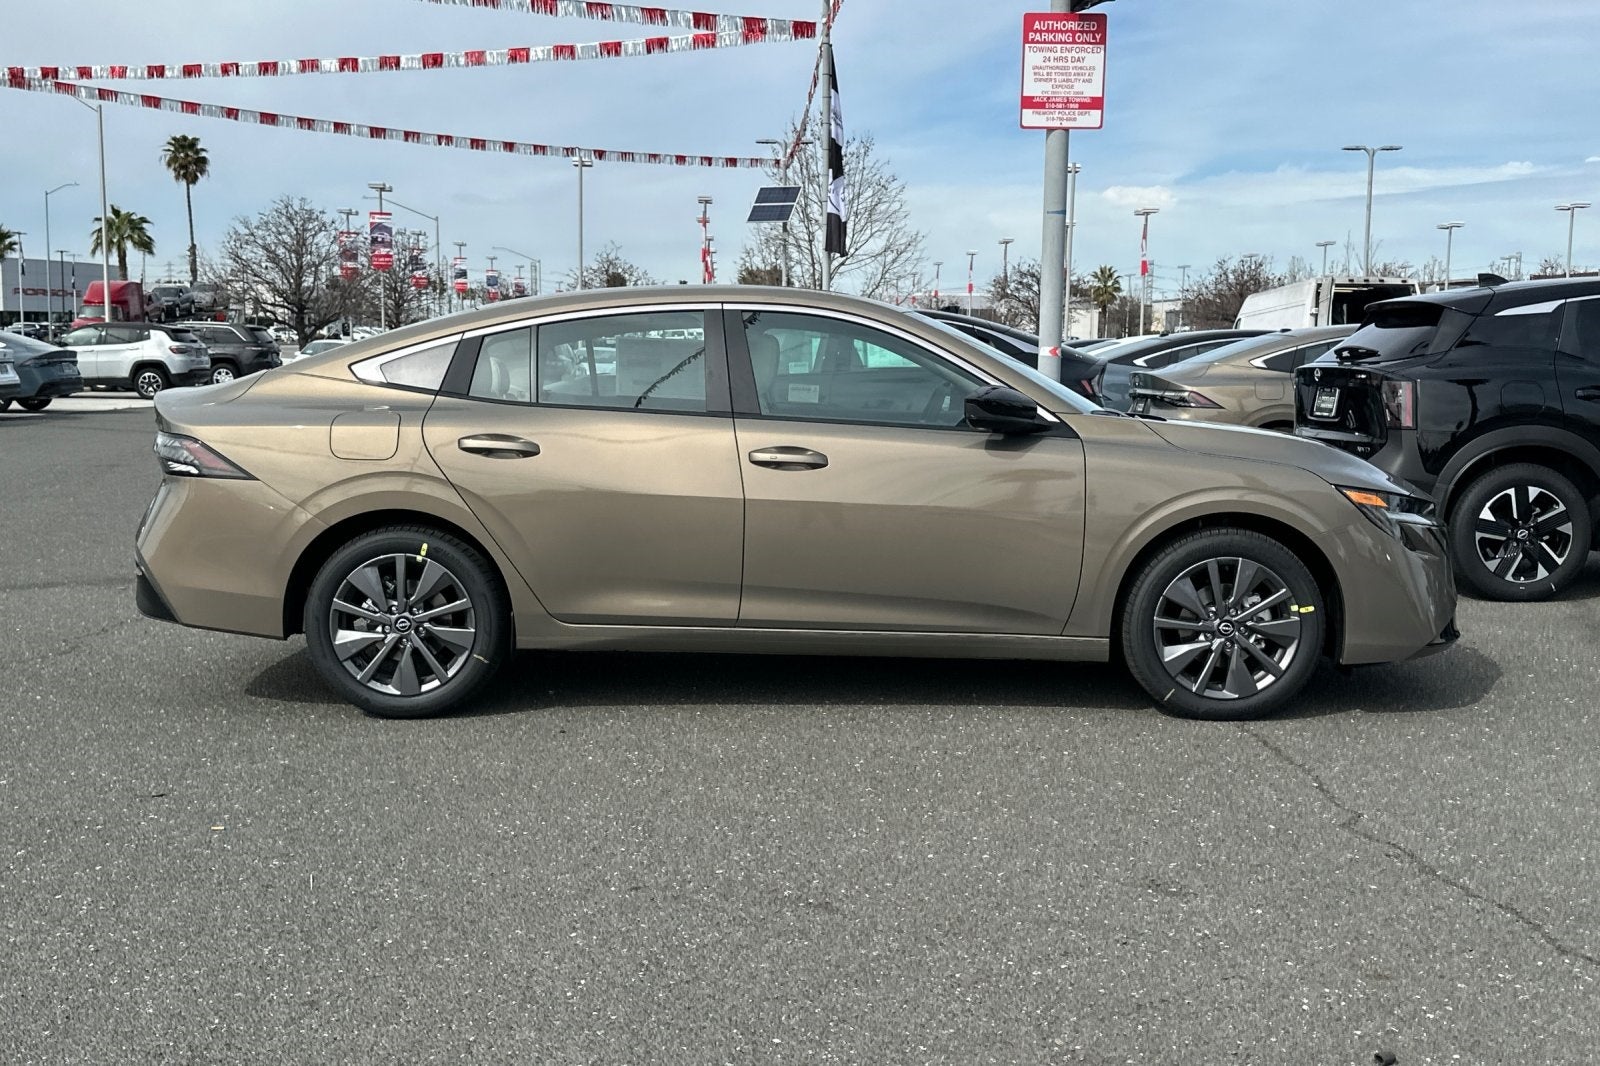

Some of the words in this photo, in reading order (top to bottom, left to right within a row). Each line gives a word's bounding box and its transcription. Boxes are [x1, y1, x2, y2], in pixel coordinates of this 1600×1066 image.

[1033, 21, 1097, 31] AUTHORIZED
[1028, 32, 1073, 42] PARKING
[1075, 33, 1102, 42] ONLY
[1028, 46, 1058, 54] TOWING
[1060, 46, 1102, 54] ENFORCED
